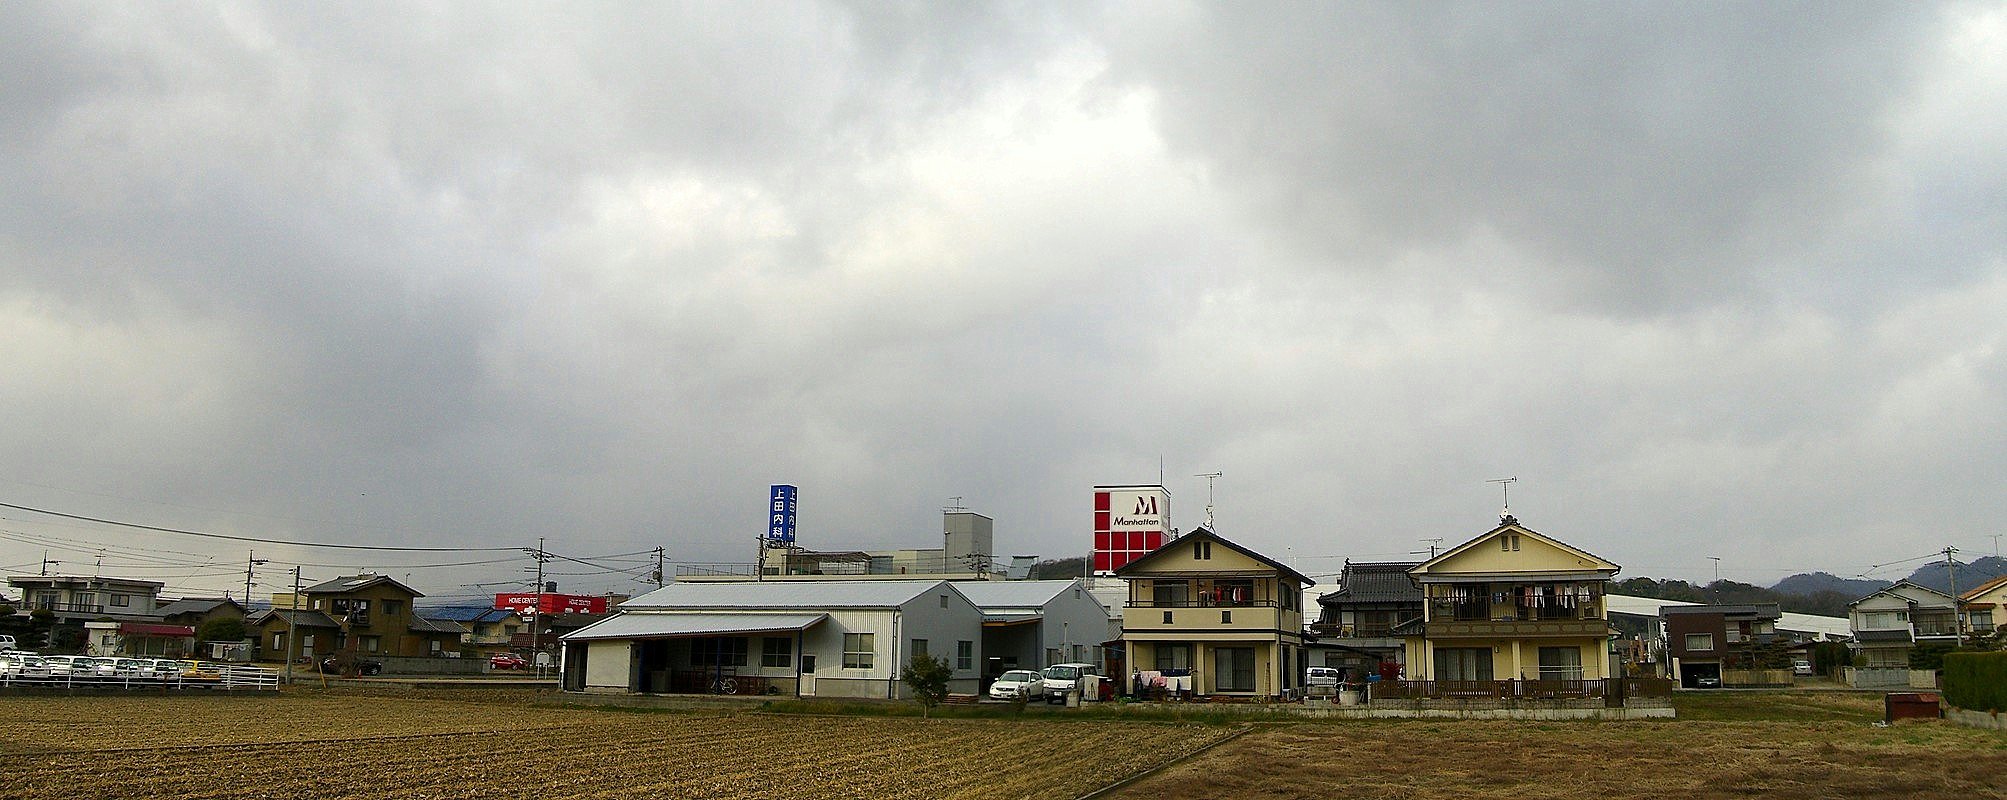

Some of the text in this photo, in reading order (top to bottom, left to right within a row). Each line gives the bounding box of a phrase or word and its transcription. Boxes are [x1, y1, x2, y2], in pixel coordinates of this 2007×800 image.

[773, 488, 784, 537] 上田内科
[788, 489, 796, 538] 上田内科
[1113, 516, 1159, 526] Manhattan
